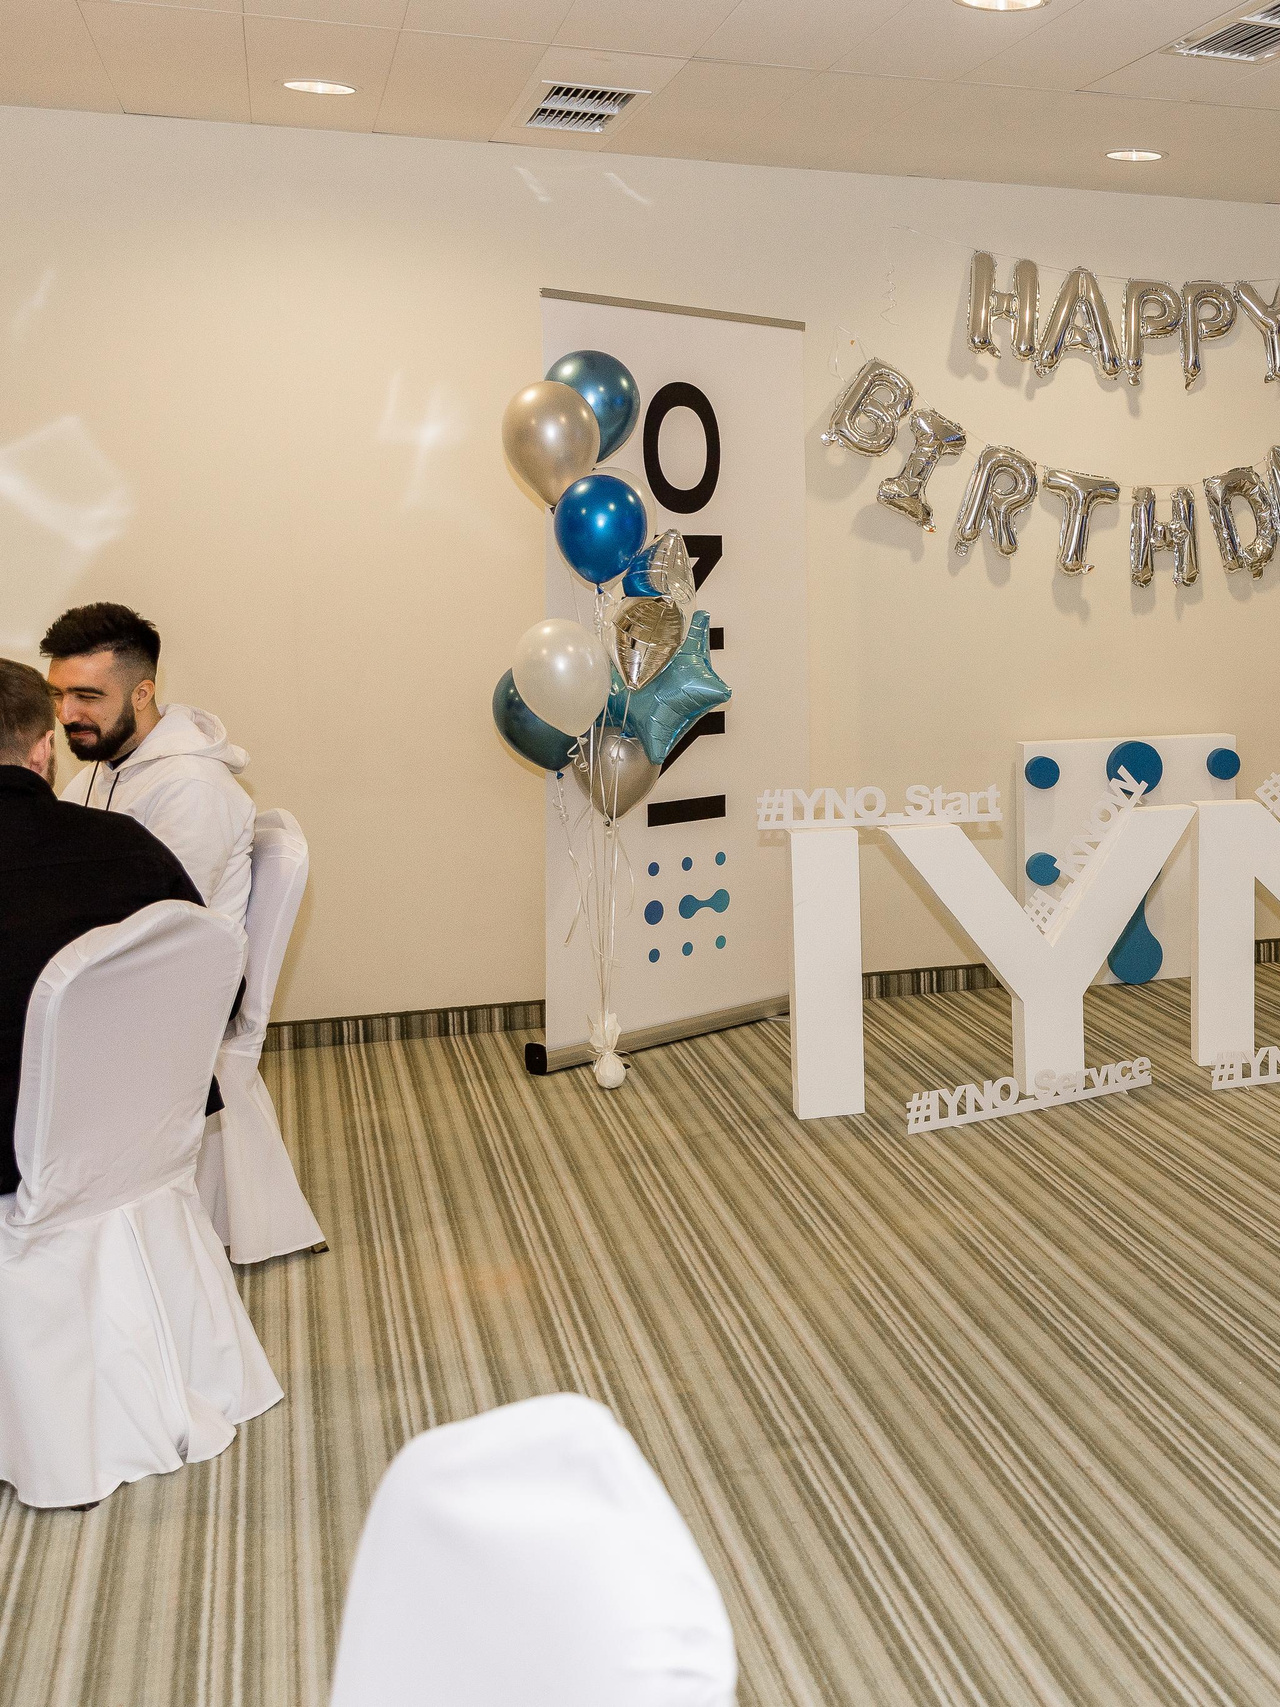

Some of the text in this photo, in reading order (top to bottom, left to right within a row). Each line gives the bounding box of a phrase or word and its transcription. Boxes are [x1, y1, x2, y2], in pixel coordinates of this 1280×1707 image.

[642, 381, 727, 828] IO
[757, 783, 1002, 828] #IYNO_Start
[906, 1056, 1152, 1132] #IYNO_Service
